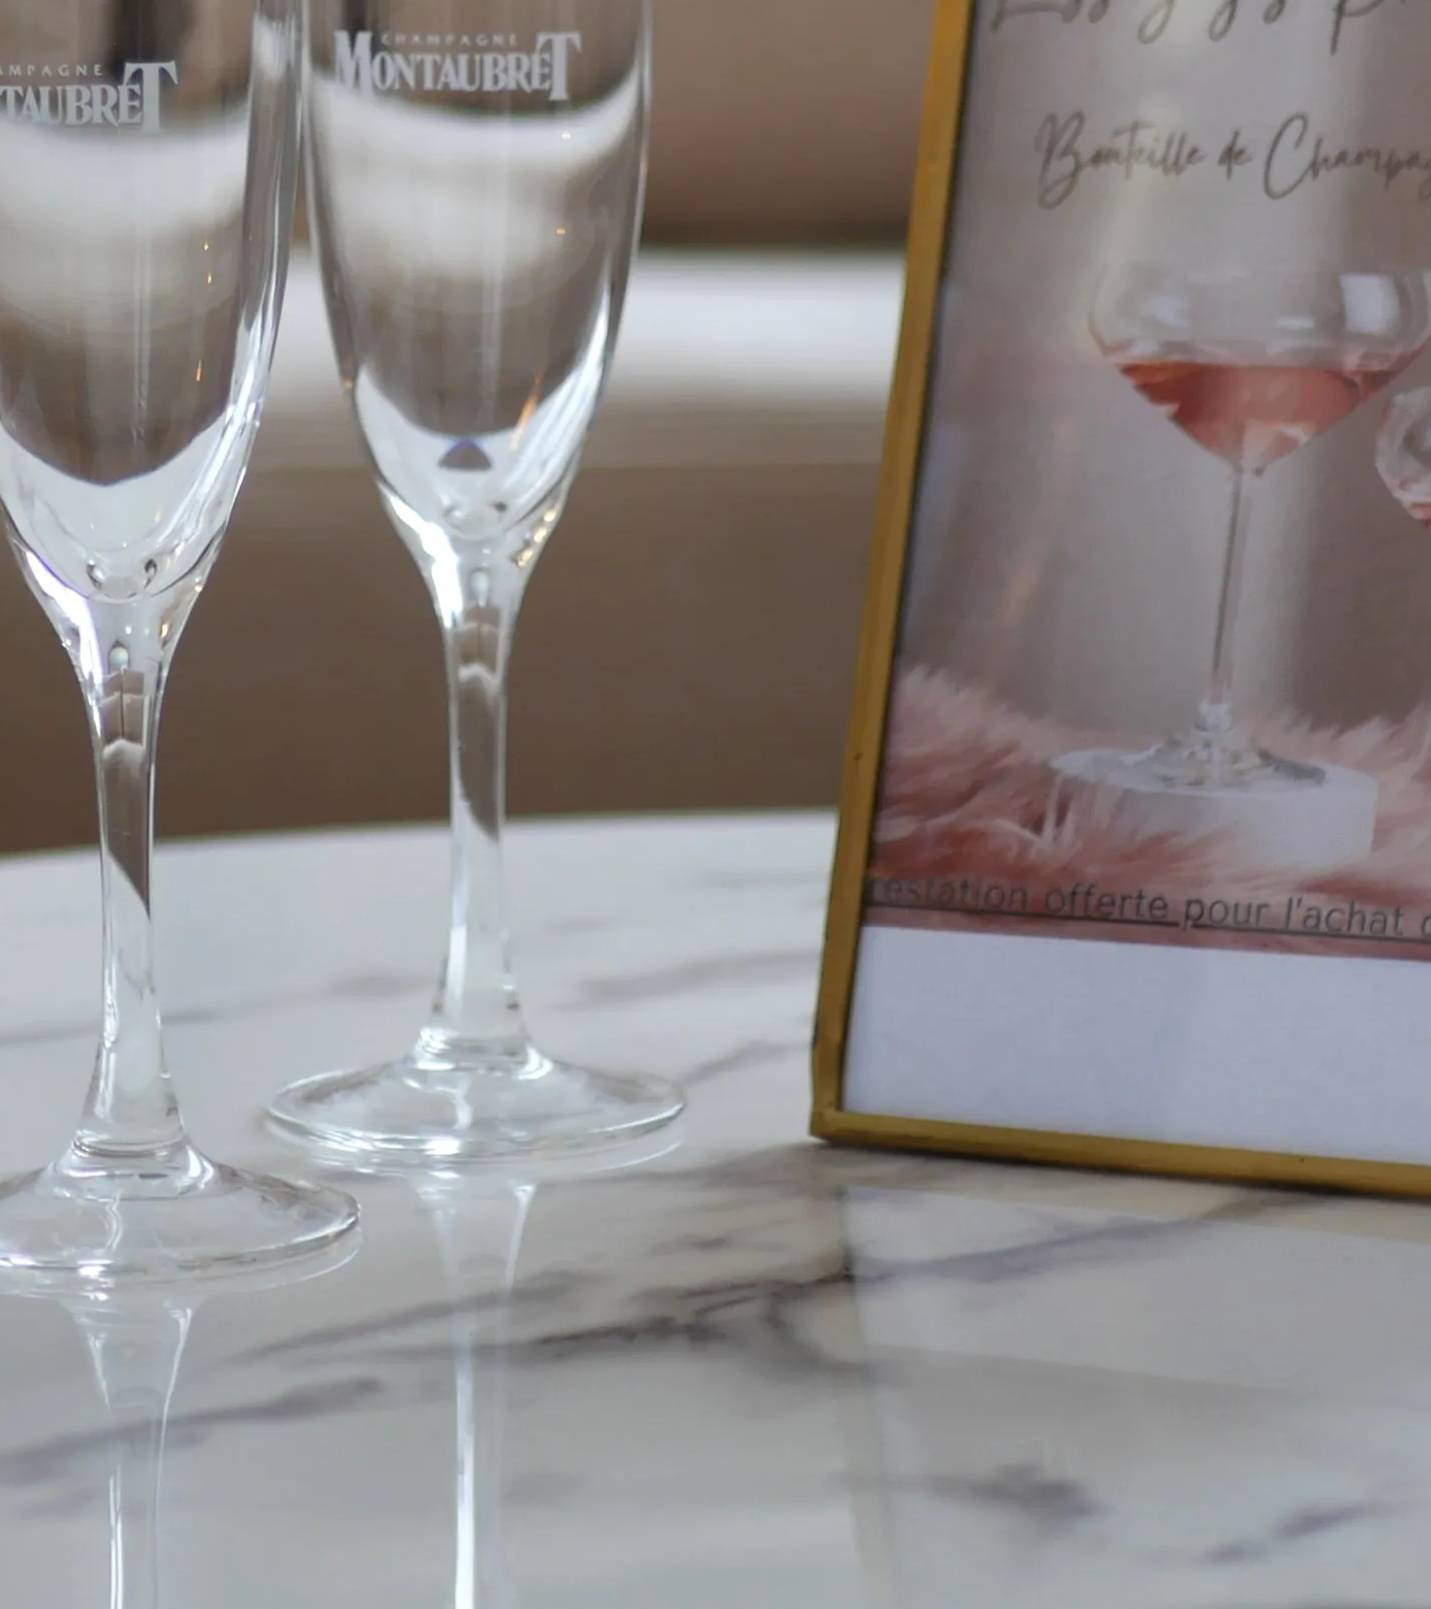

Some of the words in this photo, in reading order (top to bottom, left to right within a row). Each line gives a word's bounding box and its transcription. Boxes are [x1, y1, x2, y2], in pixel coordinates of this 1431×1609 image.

[381, 33, 518, 47] CHAMPAGNE
[1217, 127, 1254, 181] de
[1046, 883, 1169, 923] offerte
[1185, 896, 1268, 931] pour
[1286, 895, 1405, 937] l'achat
